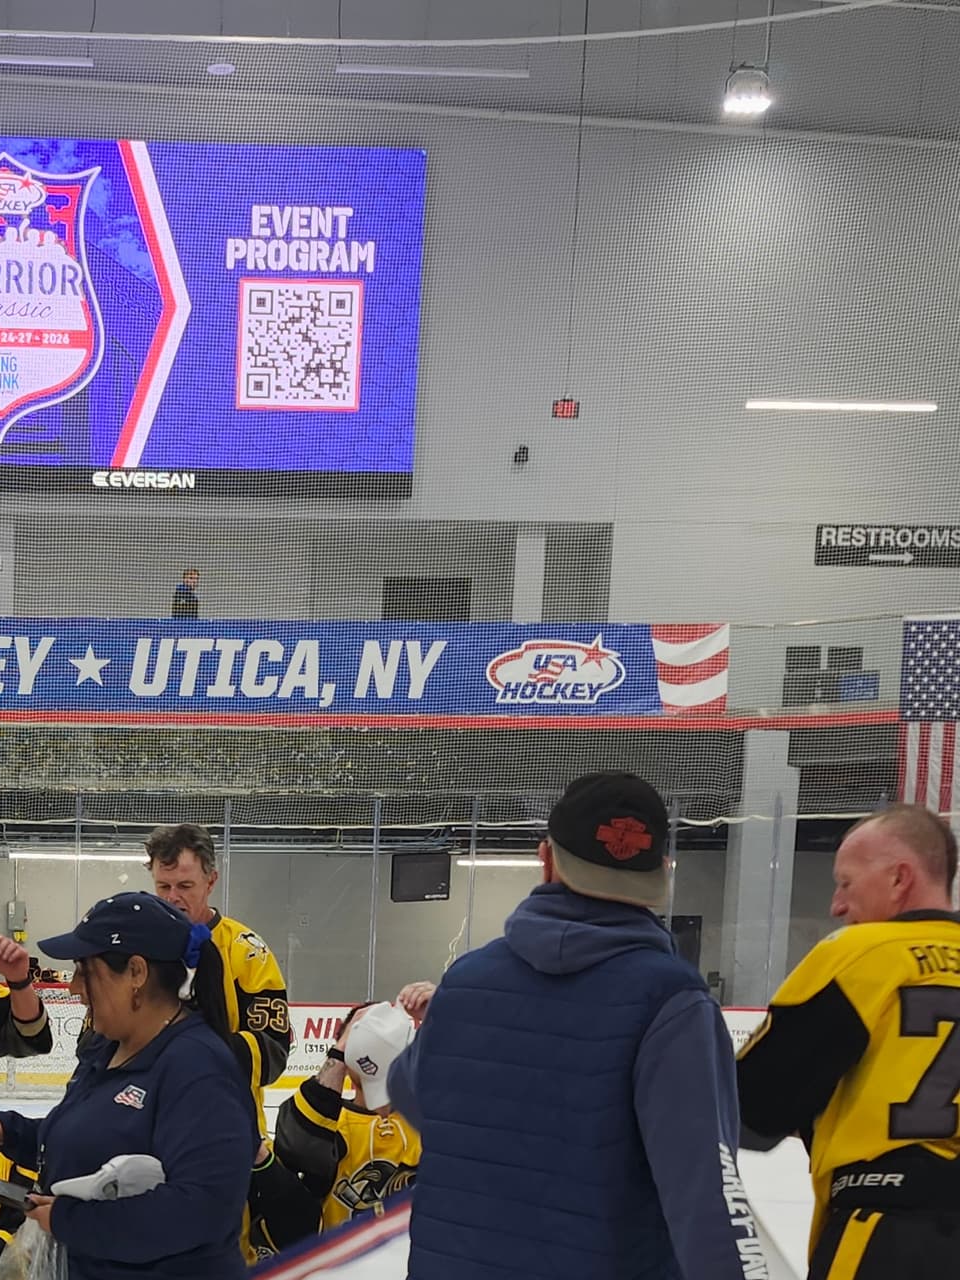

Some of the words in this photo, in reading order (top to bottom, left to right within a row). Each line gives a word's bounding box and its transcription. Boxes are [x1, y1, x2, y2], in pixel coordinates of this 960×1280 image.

[251, 205, 354, 238] EVENT
[225, 238, 375, 273] PROGRAM
[42, 333, 70, 344] 2026
[109, 472, 196, 489] EVERSAN
[820, 527, 960, 548] RESTROOMS
[129, 636, 335, 708] UTICA,
[353, 639, 449, 699] NY
[533, 653, 578, 672] USA
[500, 681, 603, 701] HOCKEY
[247, 997, 290, 1034] 53
[304, 1043, 329, 1054] (315)
